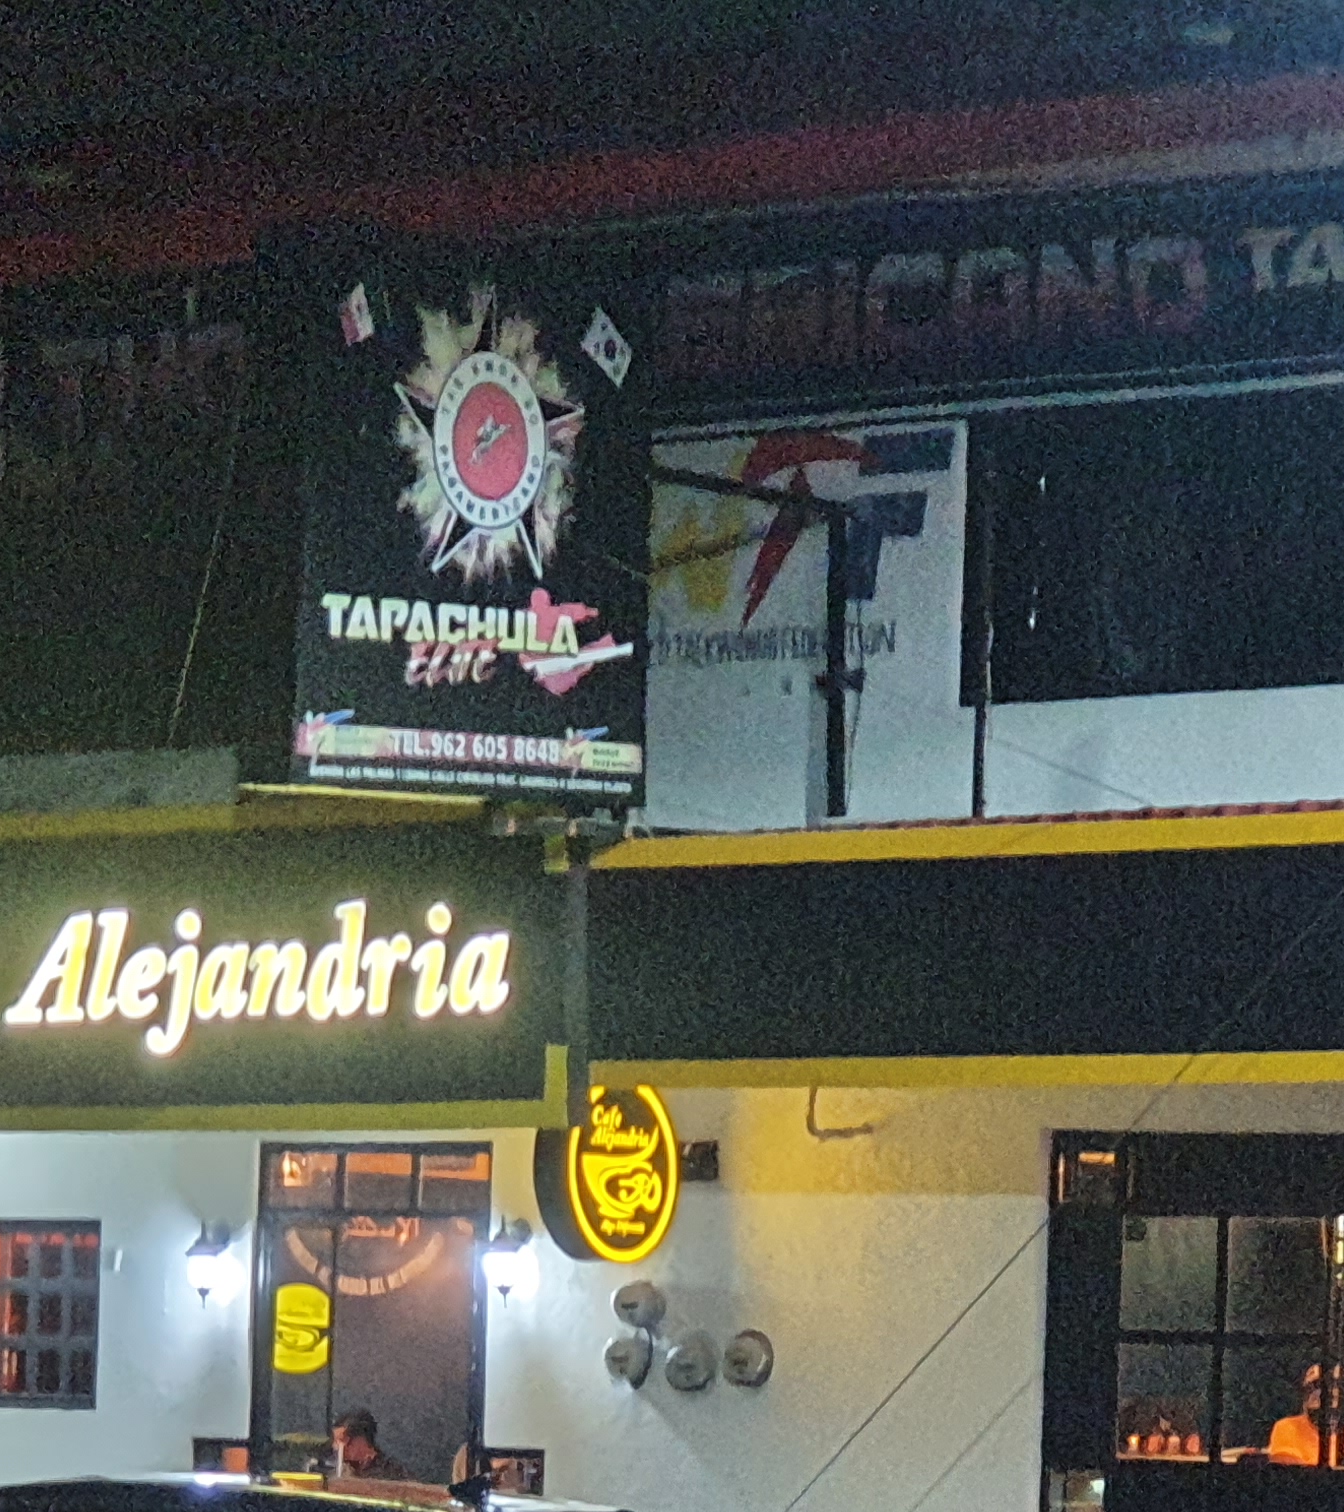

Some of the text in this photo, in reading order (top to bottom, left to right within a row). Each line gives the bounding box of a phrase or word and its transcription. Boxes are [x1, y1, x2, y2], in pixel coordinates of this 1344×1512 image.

[321, 592, 579, 656] TAPACHULA
[471, 734, 508, 761] 605
[2, 897, 512, 1060] Alejandria
[591, 1104, 623, 1131] Cafe
